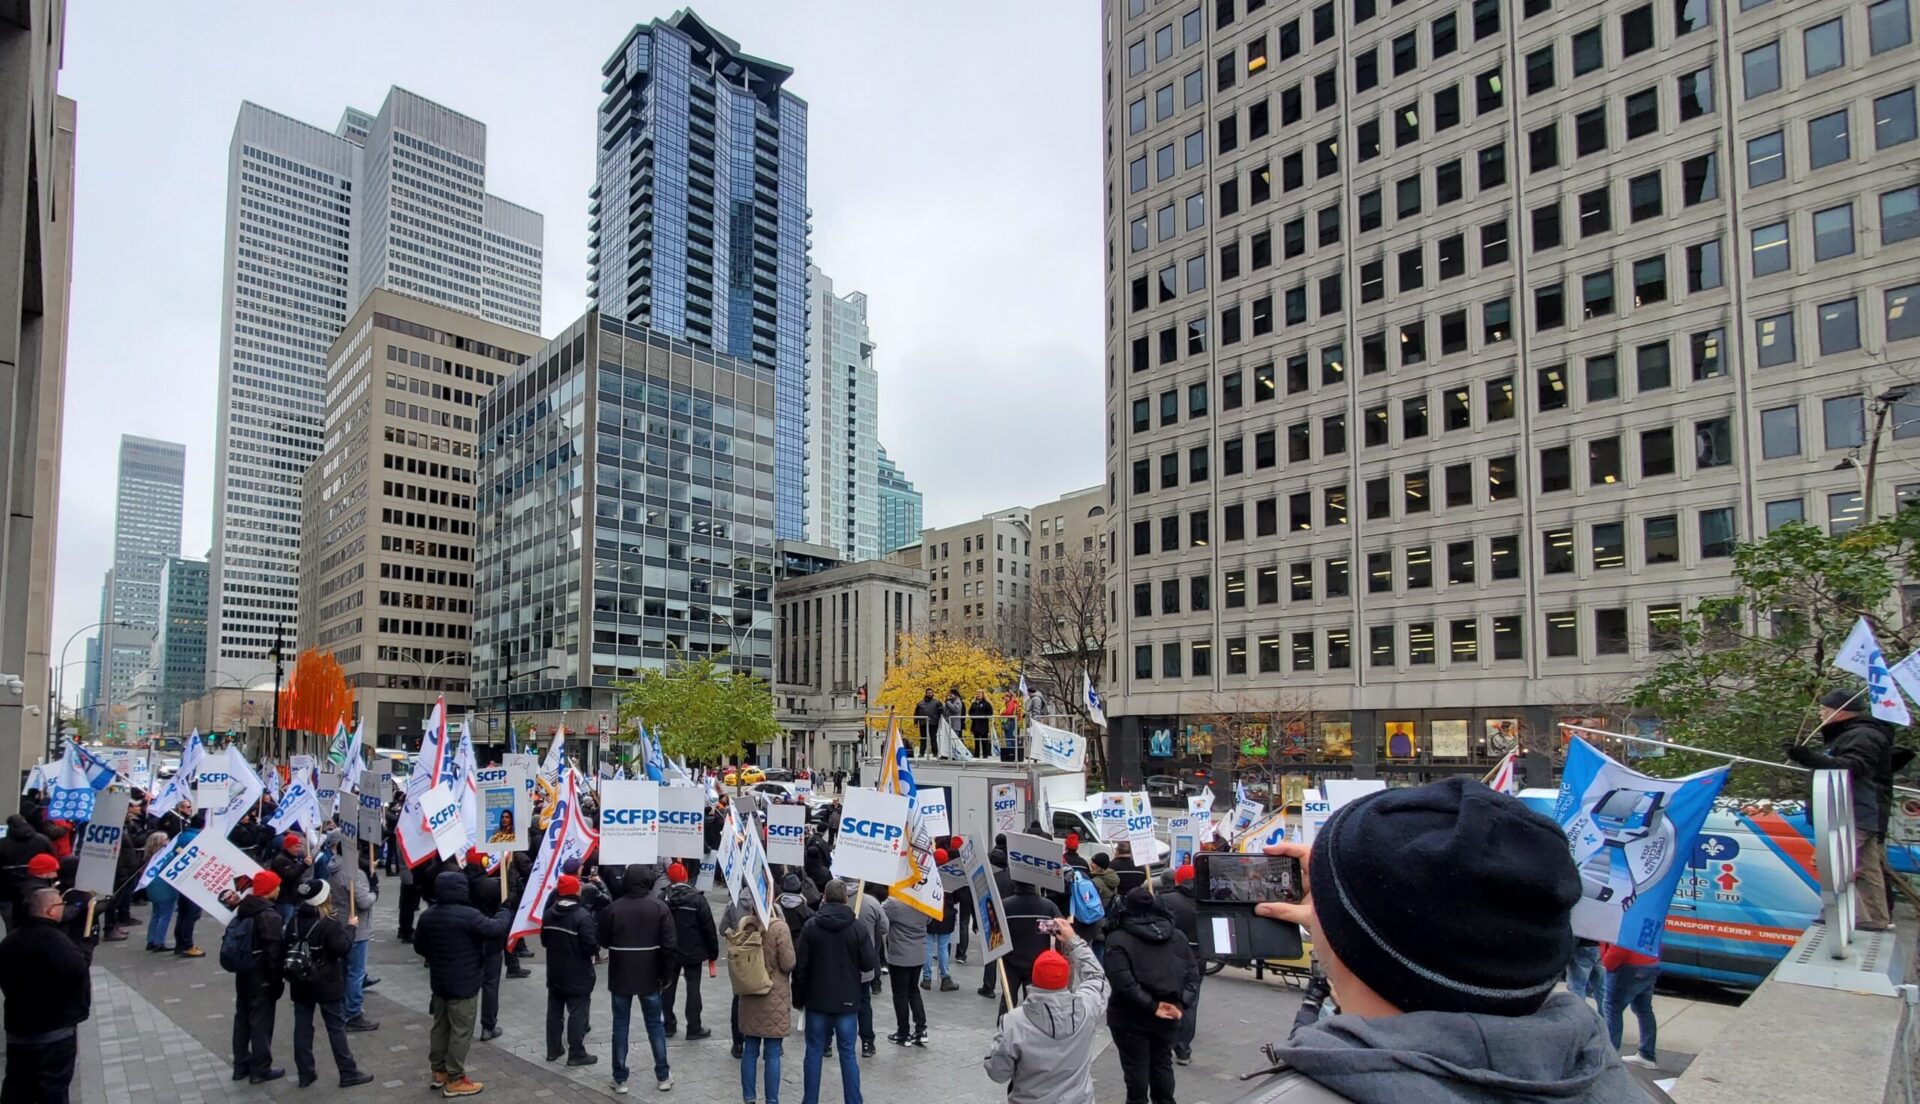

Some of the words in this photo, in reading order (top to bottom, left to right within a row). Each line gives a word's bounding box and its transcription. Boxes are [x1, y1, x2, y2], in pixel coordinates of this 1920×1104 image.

[200, 773, 228, 783] SCFP
[477, 770, 507, 782] SCFP
[317, 789, 335, 798] SCFP
[360, 794, 380, 810] SCFP
[921, 804, 945, 815] CFP
[994, 800, 1016, 811] SCFP
[1241, 800, 1255, 808] SCFP
[429, 804, 456, 829] SCFP
[603, 809, 657, 824] SCFP
[658, 811, 703, 825] SCFP
[1128, 816, 1152, 831] SCFP
[1172, 819, 1188, 828] SCFP
[86, 824, 120, 844] SCFP
[340, 820, 356, 839] SCFP
[768, 825, 803, 837] SCFP
[841, 817, 902, 841] SCFP
[165, 846, 199, 881] SCFP
[193, 856, 216, 880] RETOUR
[1009, 851, 1061, 871] SCFP
[202, 872, 211, 880] DE
[210, 863, 219, 872] LA
[203, 864, 226, 887] CLASSE
[207, 867, 232, 891] SARDINE
[1689, 877, 1707, 887] de
[213, 886, 223, 894] EN
[1665, 919, 1716, 931] TRANSPORT
[1717, 925, 1752, 935] AÉRIEN
